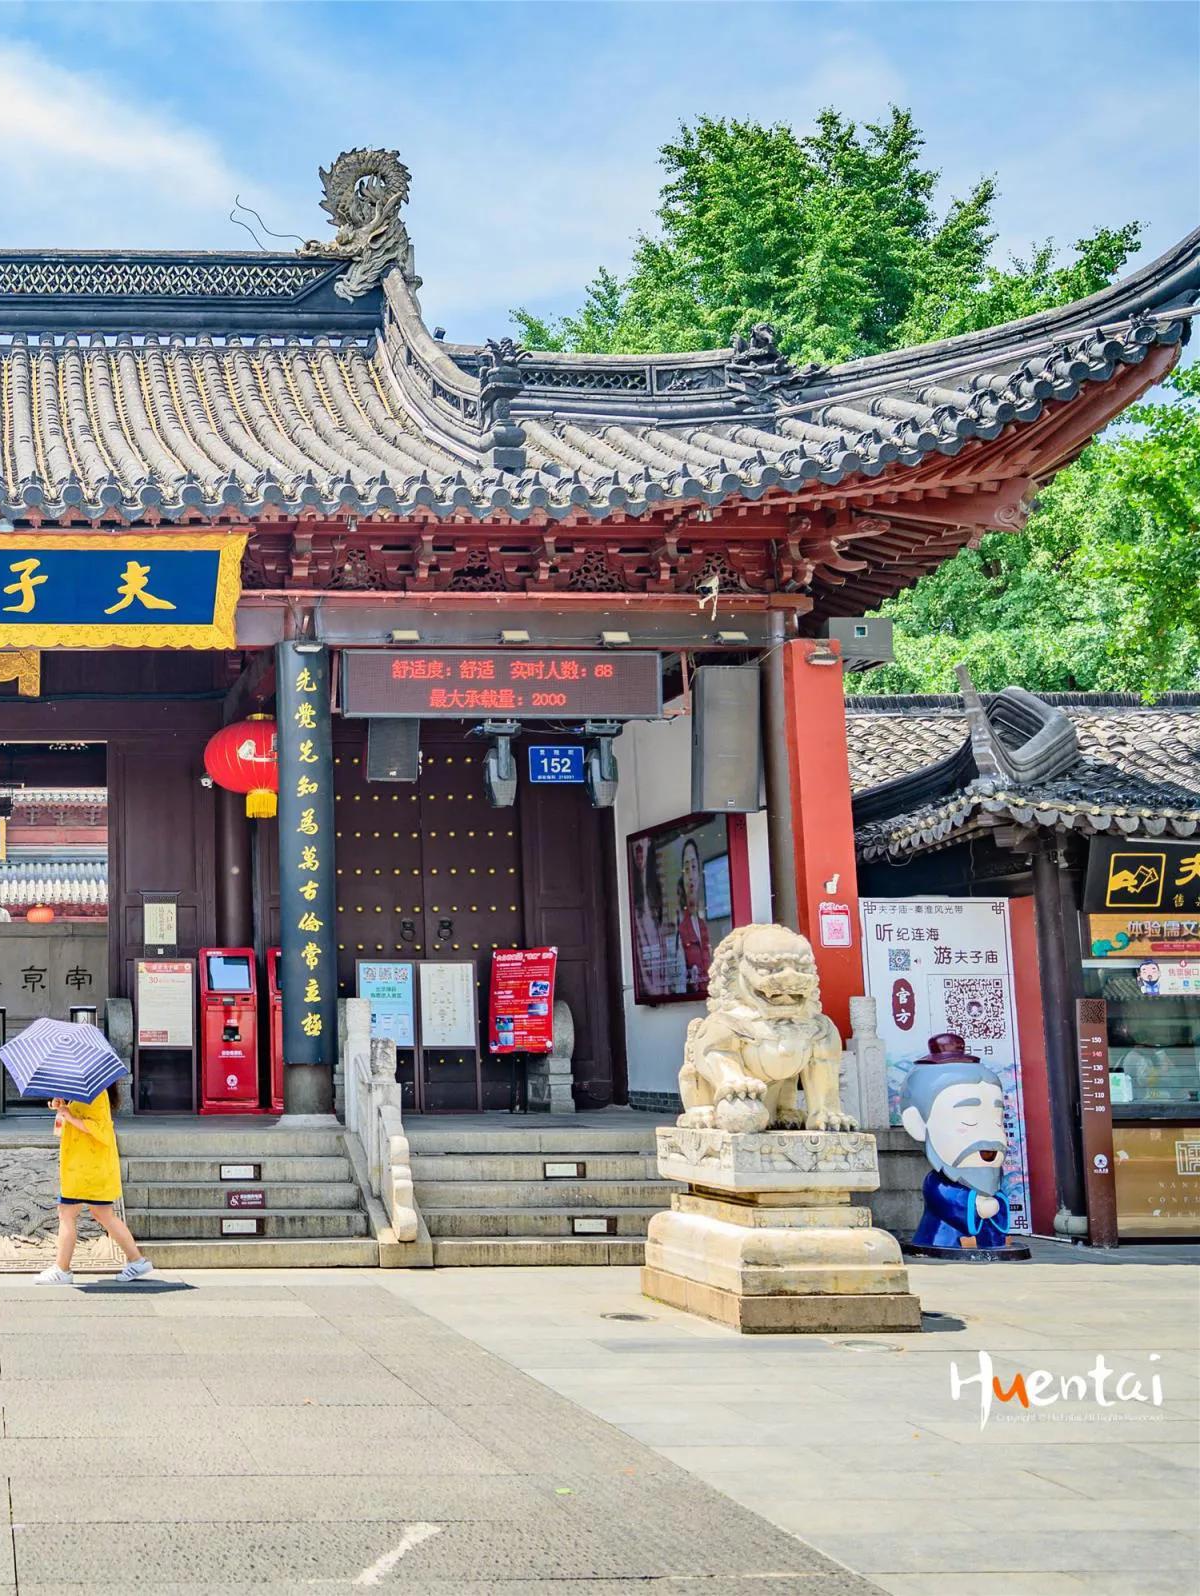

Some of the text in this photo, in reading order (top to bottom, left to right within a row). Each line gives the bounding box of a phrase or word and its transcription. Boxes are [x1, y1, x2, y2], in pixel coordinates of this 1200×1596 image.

[540, 757, 572, 773] 152
[875, 923, 940, 942] 听纪连海
[1127, 920, 1200, 939] 体验儒文
[933, 946, 999, 965] 游夫子庙
[895, 987, 911, 1024] 官方
